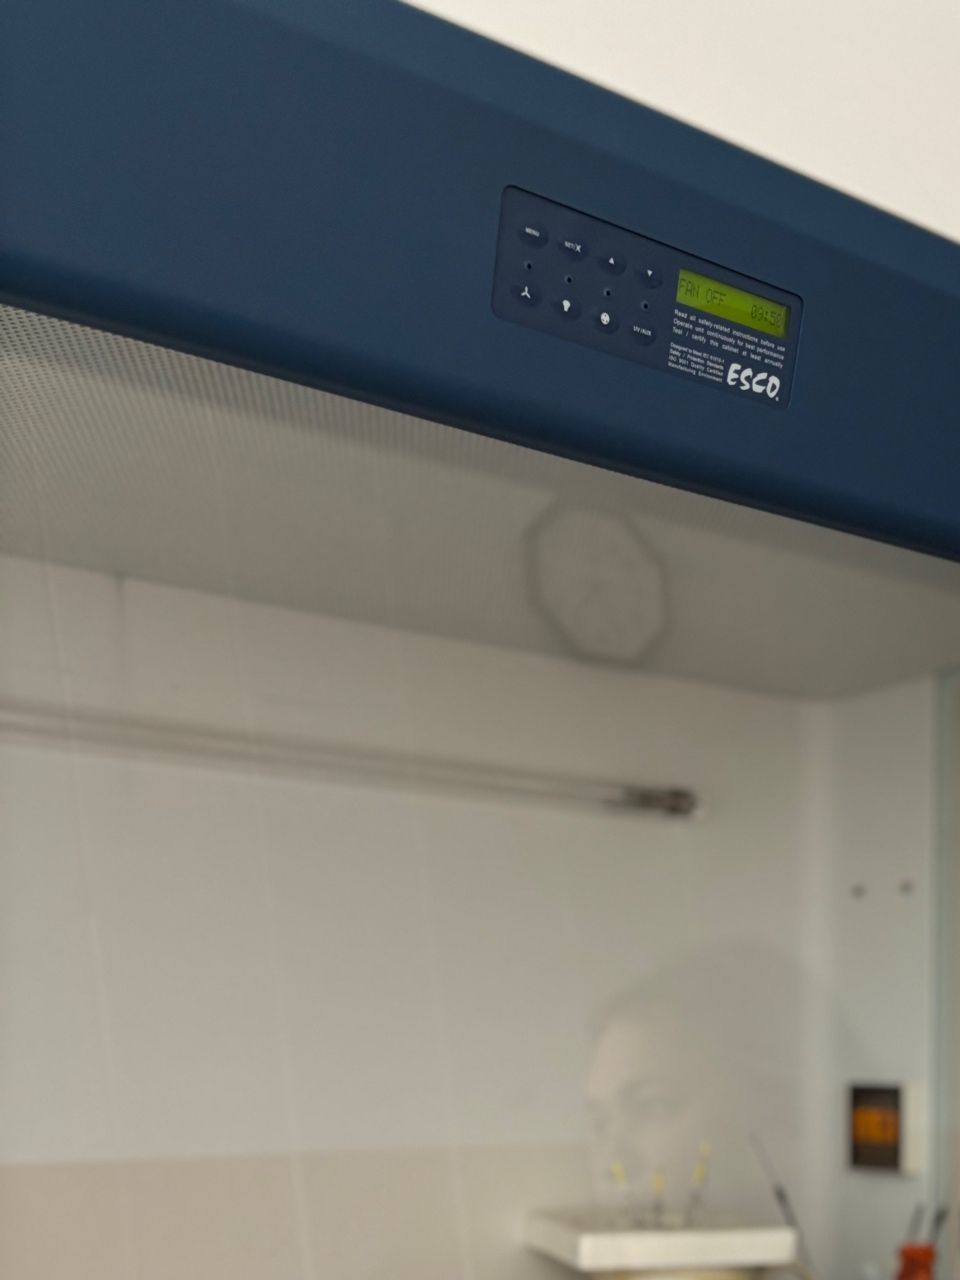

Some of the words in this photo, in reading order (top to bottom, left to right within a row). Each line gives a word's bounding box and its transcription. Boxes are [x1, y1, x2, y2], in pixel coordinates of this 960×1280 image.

[679, 279, 699, 299] FAN
[706, 288, 727, 306] OFF
[673, 318, 694, 330] Operate
[674, 309, 688, 318] Read
[761, 339, 775, 348] before
[727, 363, 780, 399] ESCO
